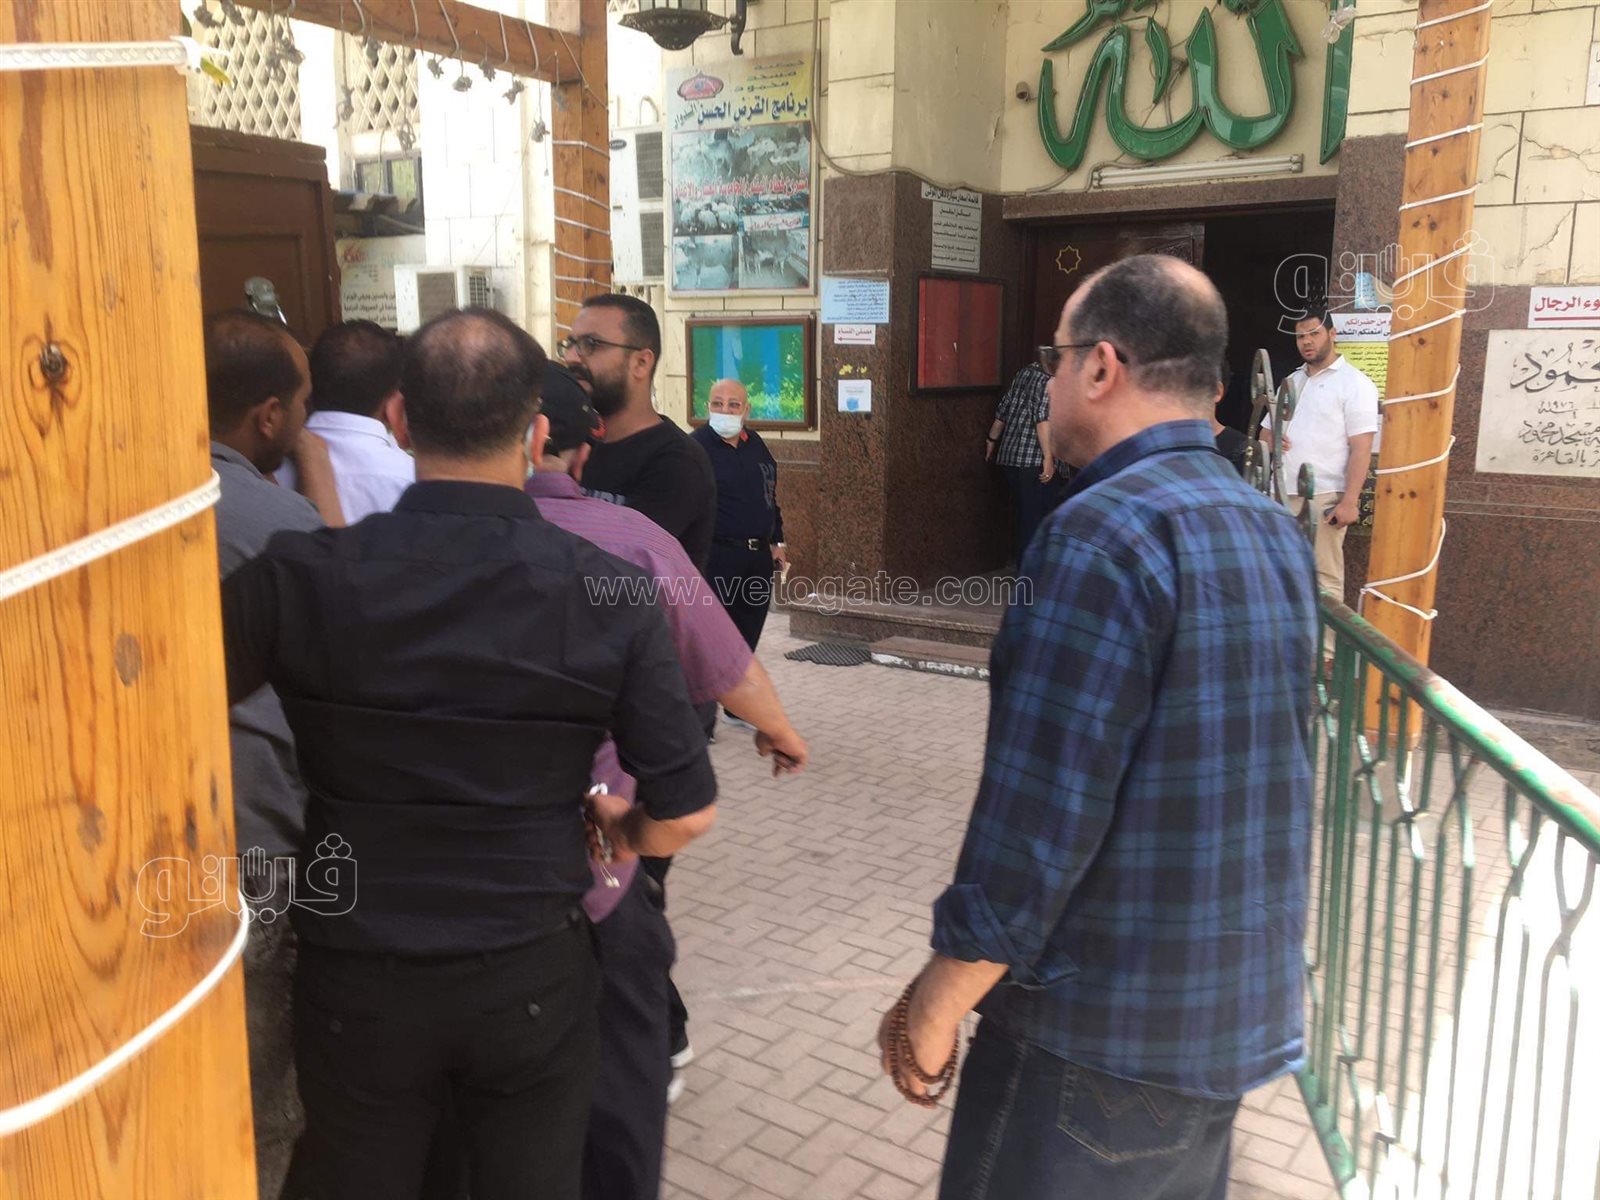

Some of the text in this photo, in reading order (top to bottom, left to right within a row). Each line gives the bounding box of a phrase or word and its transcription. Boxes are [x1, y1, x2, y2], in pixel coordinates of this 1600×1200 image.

[697, 101, 731, 124] الحسن
[733, 96, 769, 121] القرض
[771, 92, 808, 119] برنامج
[1534, 296, 1581, 312] الرجال
